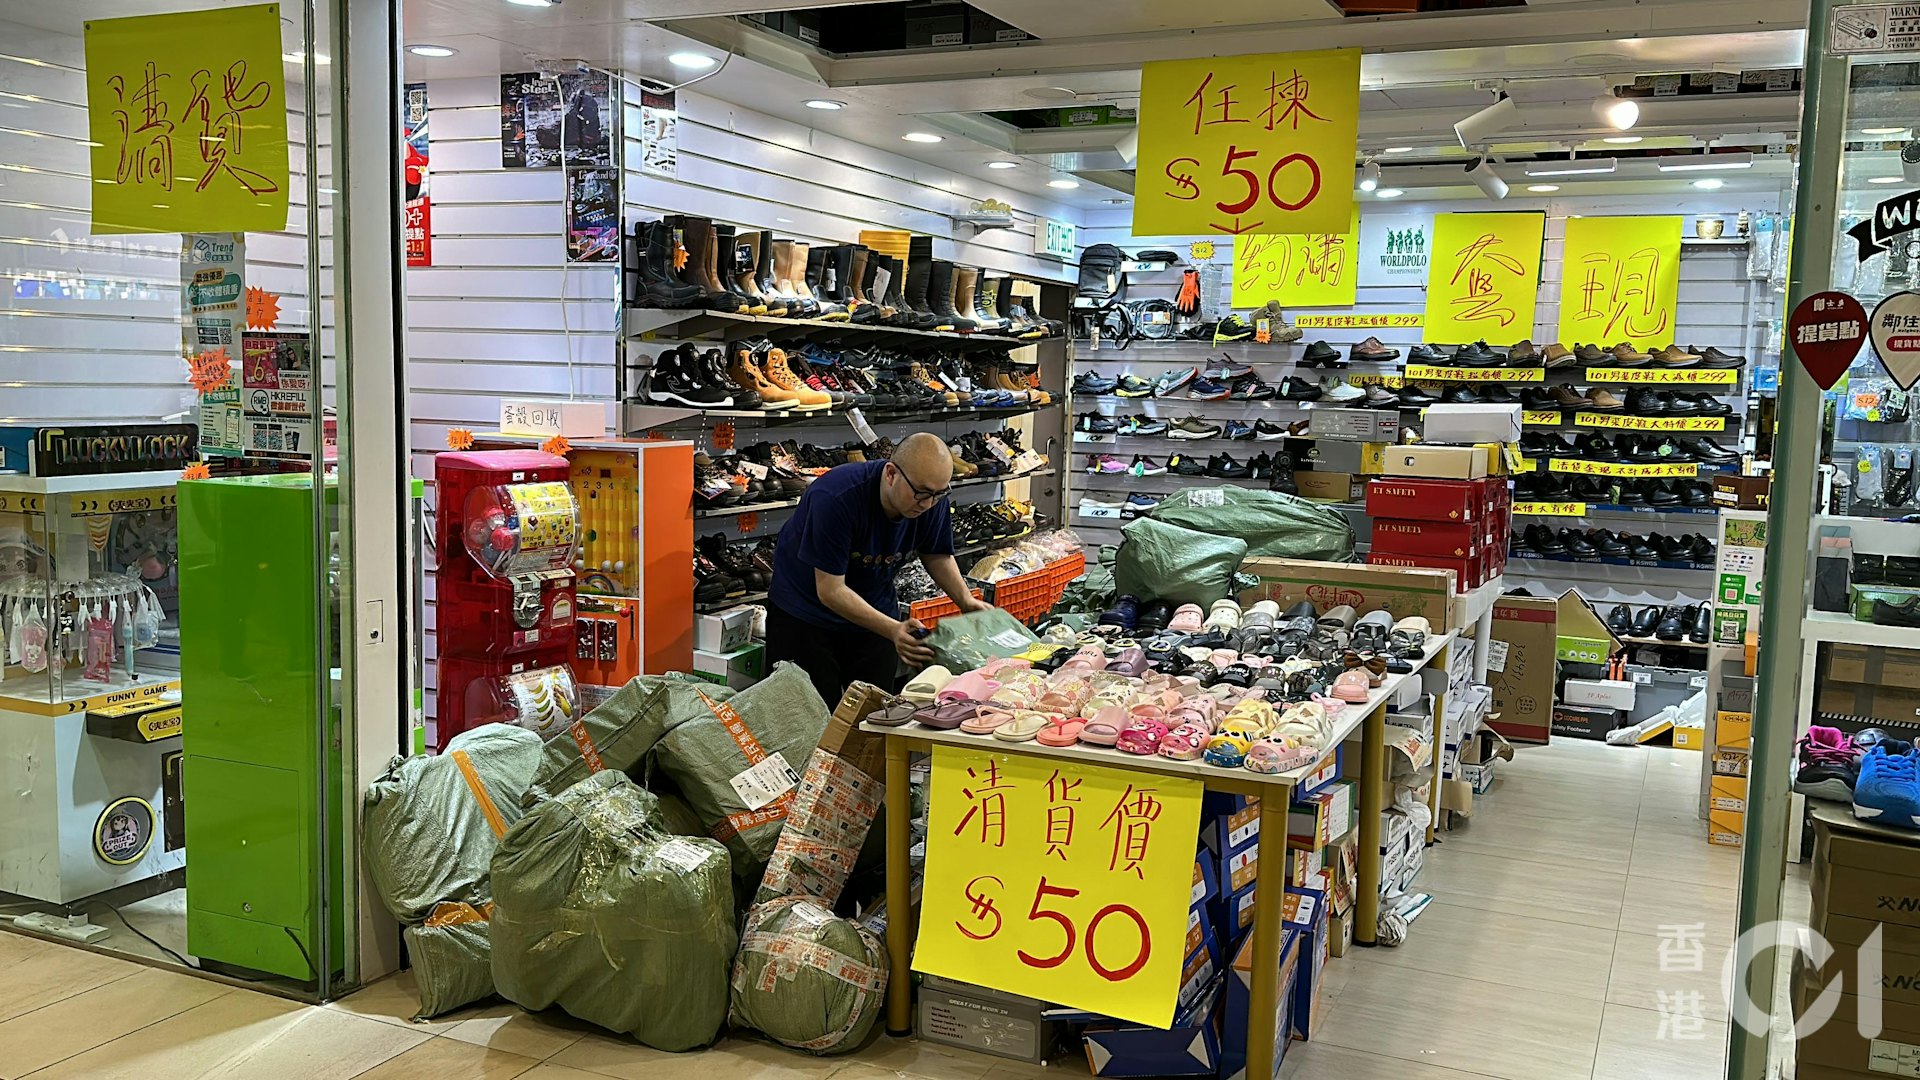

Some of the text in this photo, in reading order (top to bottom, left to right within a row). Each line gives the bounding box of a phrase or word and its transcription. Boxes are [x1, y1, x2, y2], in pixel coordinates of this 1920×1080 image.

[1184, 69, 1333, 134] 任揀
[1047, 223, 1061, 251] EXIT
[212, 243, 234, 252] Trend
[1380, 255, 1427, 267] WORLDPOLO
[1394, 316, 1419, 326] 299
[1797, 320, 1860, 344] 提貨點
[1506, 370, 1535, 382] 299
[1699, 372, 1728, 381] 299
[1692, 419, 1720, 430] 299
[1386, 487, 1417, 497] SAFETY
[1391, 524, 1422, 534] SAFETY
[1386, 559, 1417, 567] SAFETY
[106, 685, 167, 703] FUNNY GAME
[954, 759, 1162, 880] 清貨價
[108, 834, 131, 847] PRIZE
[112, 841, 128, 851] OUT
